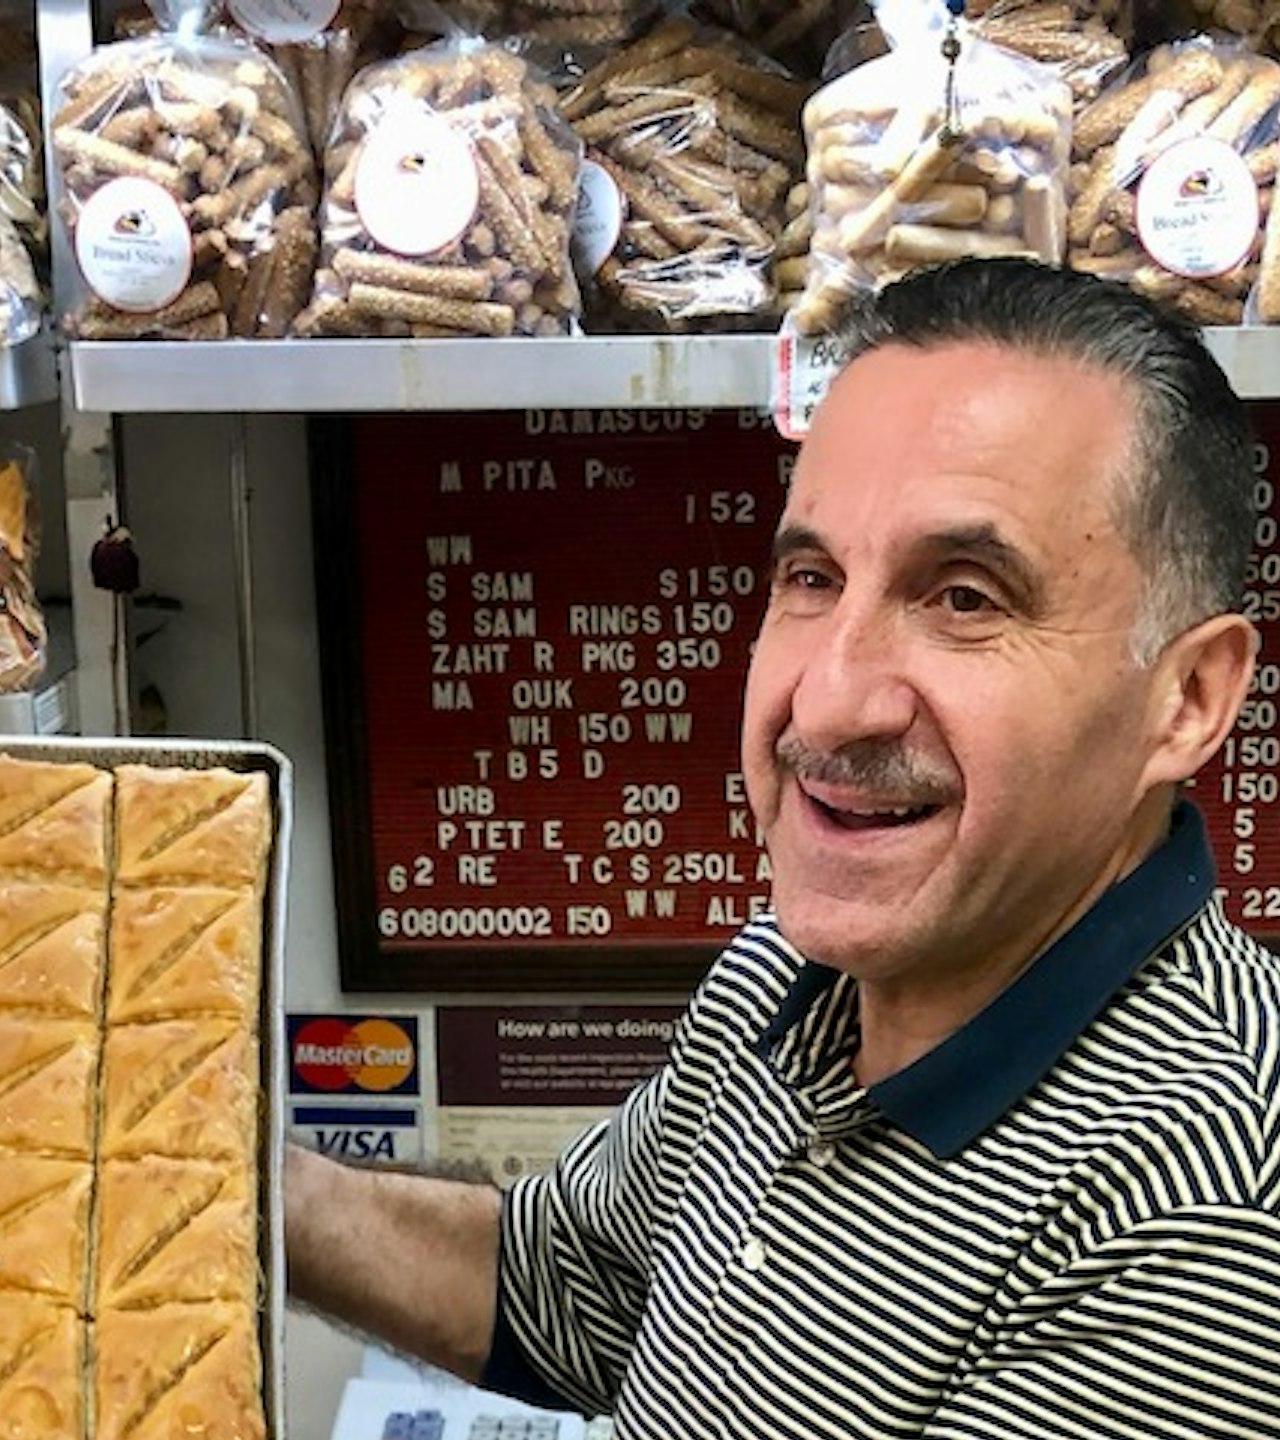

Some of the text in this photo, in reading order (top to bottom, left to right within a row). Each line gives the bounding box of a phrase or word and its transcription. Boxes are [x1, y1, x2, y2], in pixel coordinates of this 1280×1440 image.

[483, 459, 557, 492] PITA
[427, 572, 447, 601] S
[471, 571, 535, 601] SAM
[428, 609, 447, 638] S
[474, 607, 537, 638] SAM
[569, 603, 662, 636] RINGS
[432, 639, 721, 675] ZAHT R PKG 350
[432, 677, 687, 711] MA OUK 200
[508, 714, 551, 746] WH
[578, 713, 631, 744] 150
[1223, 736, 1280, 768] 150
[437, 785, 495, 816] URB
[622, 783, 681, 814] 200
[1221, 772, 1279, 803] 150
[603, 818, 664, 850] 200
[1233, 808, 1255, 839] 5
[458, 854, 498, 887] RE
[1233, 844, 1255, 875] 5
[566, 906, 612, 936] 150
[497, 1019, 546, 1038] How
[548, 1021, 580, 1038] are
[582, 1021, 614, 1038] we
[295, 1045, 412, 1067] MasterCard
[316, 1131, 395, 1158] VISA
